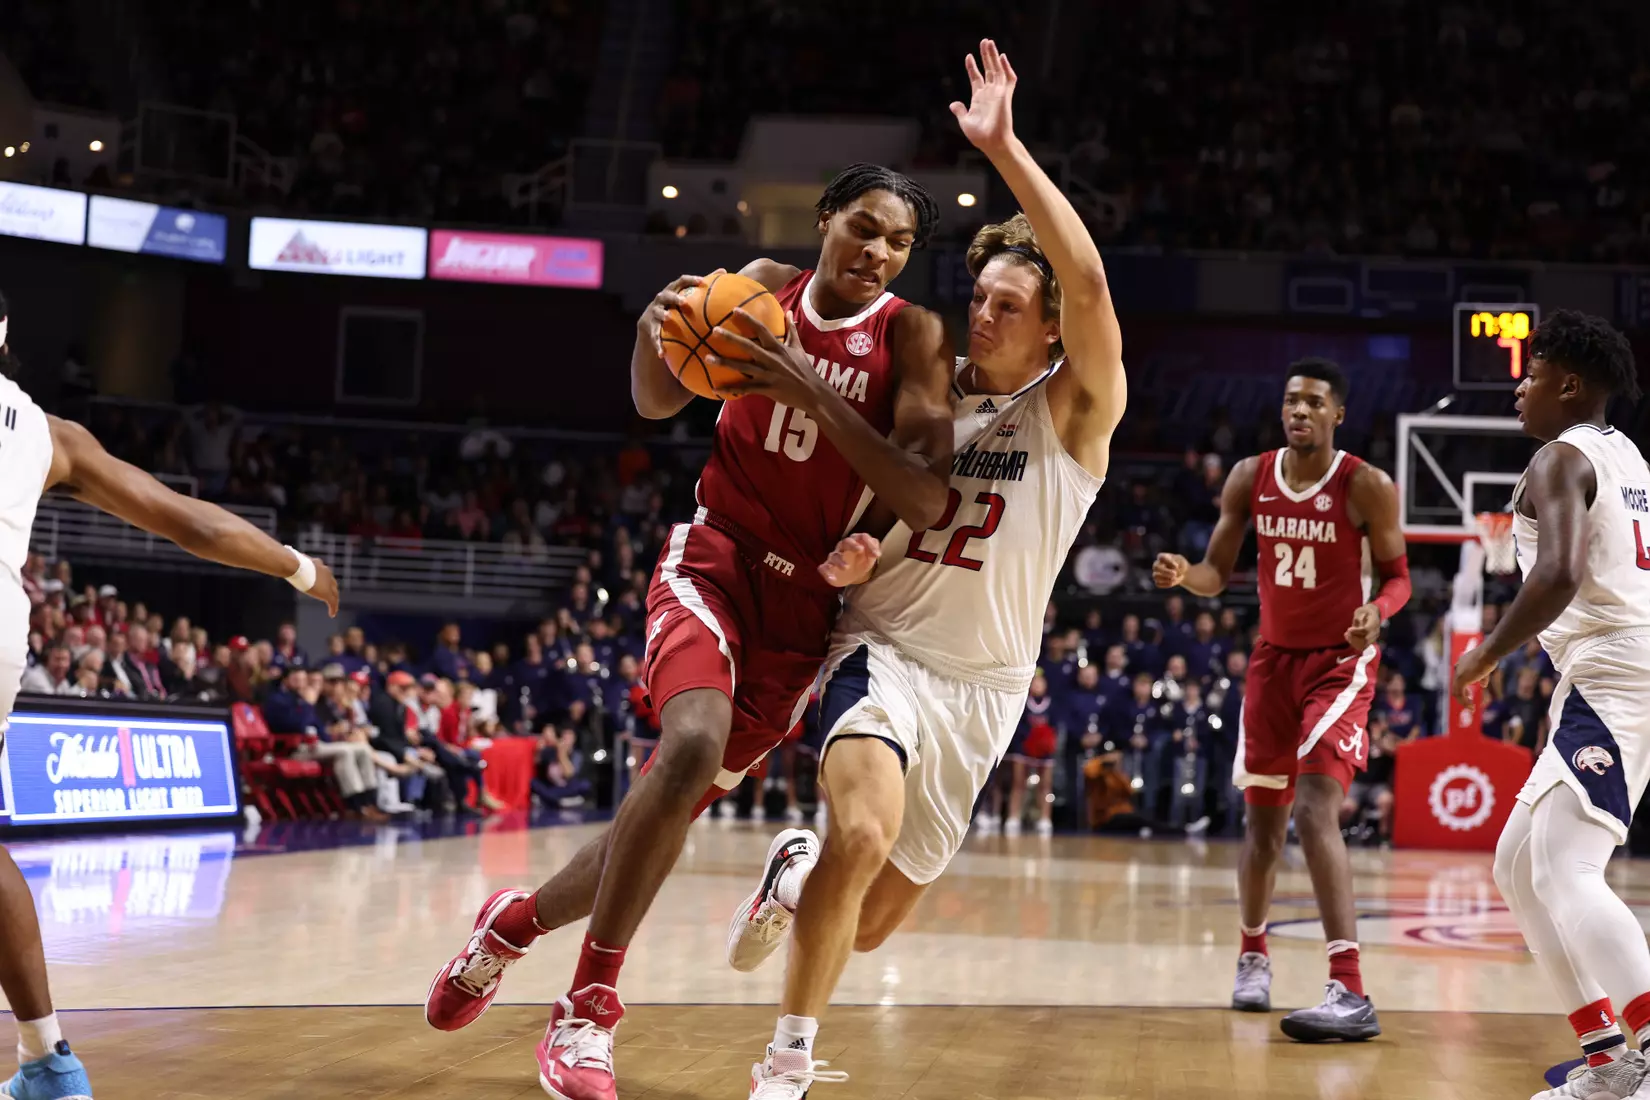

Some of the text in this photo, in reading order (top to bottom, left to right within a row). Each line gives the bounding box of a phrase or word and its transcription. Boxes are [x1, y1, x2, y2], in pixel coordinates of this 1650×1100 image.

[847, 332, 872, 355] SEC
[764, 400, 818, 462] 15
[1621, 486, 1648, 512] MOORE
[1256, 514, 1337, 543] ALABAMA
[763, 551, 795, 577] RTR
[1274, 542, 1317, 589] 24
[133, 734, 201, 779] ULTRA
[1444, 783, 1478, 814] pf
